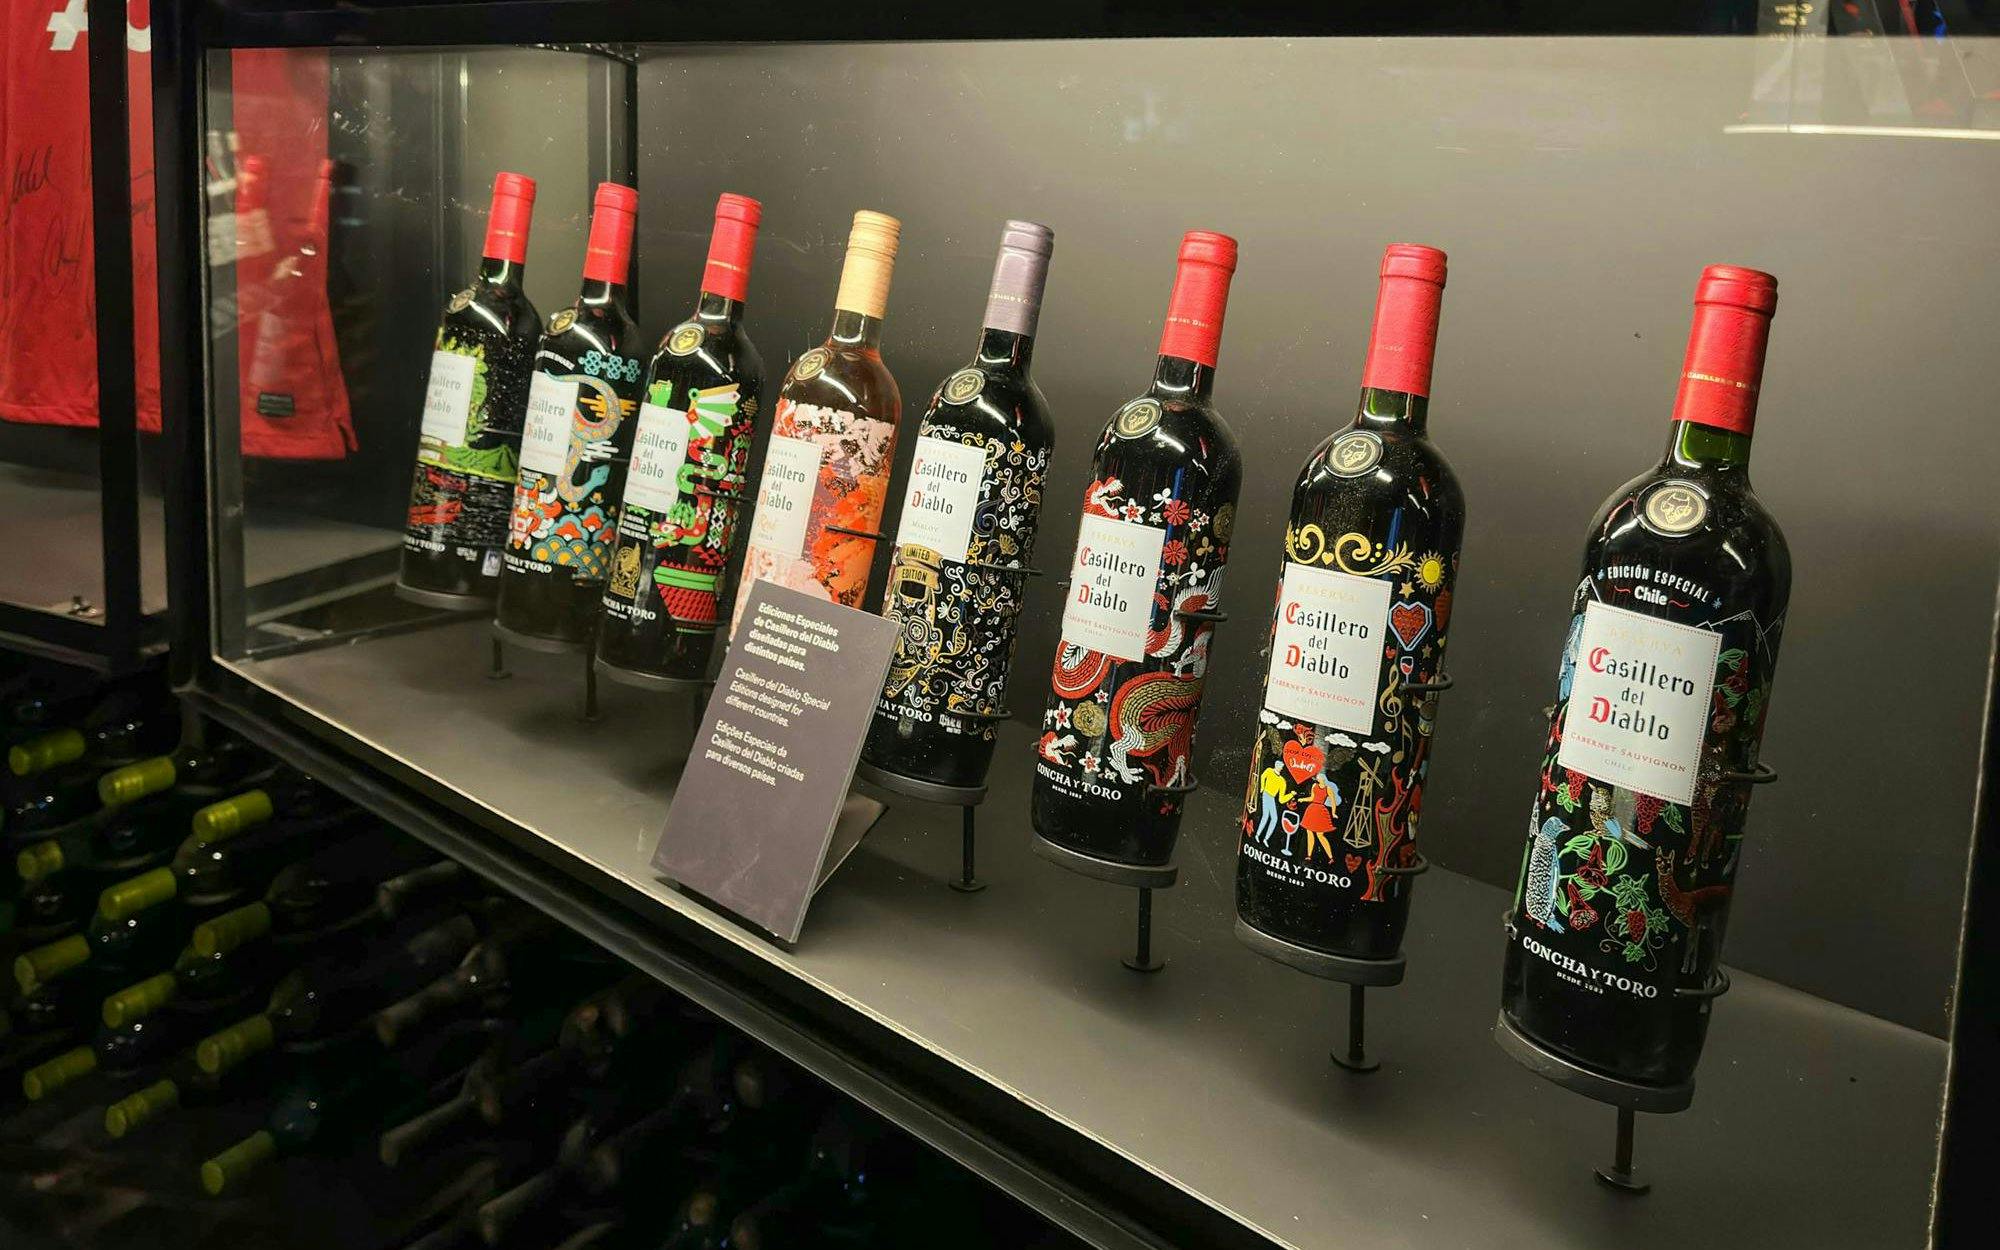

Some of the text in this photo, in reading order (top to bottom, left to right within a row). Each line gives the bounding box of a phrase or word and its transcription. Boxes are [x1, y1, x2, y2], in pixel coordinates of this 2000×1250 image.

[914, 457, 968, 484] Casillero
[927, 481, 940, 492] del
[760, 490, 793, 511] Diablo
[912, 490, 953, 515] Diablo
[905, 546, 930, 561] LIMITED
[1079, 546, 1145, 578] Casillero
[902, 568, 928, 582] EDITION
[1096, 573, 1112, 588] del
[1607, 564, 1711, 603] EDICIÓN ESPECIAL
[1077, 584, 1128, 613] Diablo
[1634, 585, 1668, 606] Chile
[625, 605, 656, 620] TORO
[758, 602, 839, 637] Ediciones Especiales
[1285, 602, 1369, 639] Casillero
[749, 629, 807, 656] diseñadas para
[753, 616, 839, 652] de Casillero del Diablo
[1308, 635, 1328, 651] del
[744, 642, 778, 661] distintos
[1285, 644, 1350, 679] Diablo
[1588, 646, 1694, 696] Casillero
[729, 680, 804, 716] Editions designed for
[735, 667, 831, 711] Casillero del Diablo Special
[1308, 687, 1366, 706] SAUVIGNON
[1621, 687, 1645, 706] del
[725, 694, 756, 714] different
[898, 705, 933, 723] TORO
[1588, 695, 1670, 740] Diablo
[711, 733, 805, 782] Casillero del Diablo criadas
[743, 731, 777, 754] Especiais
[777, 746, 788, 758] de
[1570, 733, 1687, 773] CABERNET SAUVIGNON
[704, 749, 722, 762] para
[721, 754, 752, 775] diversos
[1037, 762, 1122, 801] CONCHA Y TORO
[1243, 843, 1352, 889] CONCHA Y TORO
[1522, 936, 1658, 999] CONCHA Y TORO
[1556, 971, 1582, 986] DESDE
